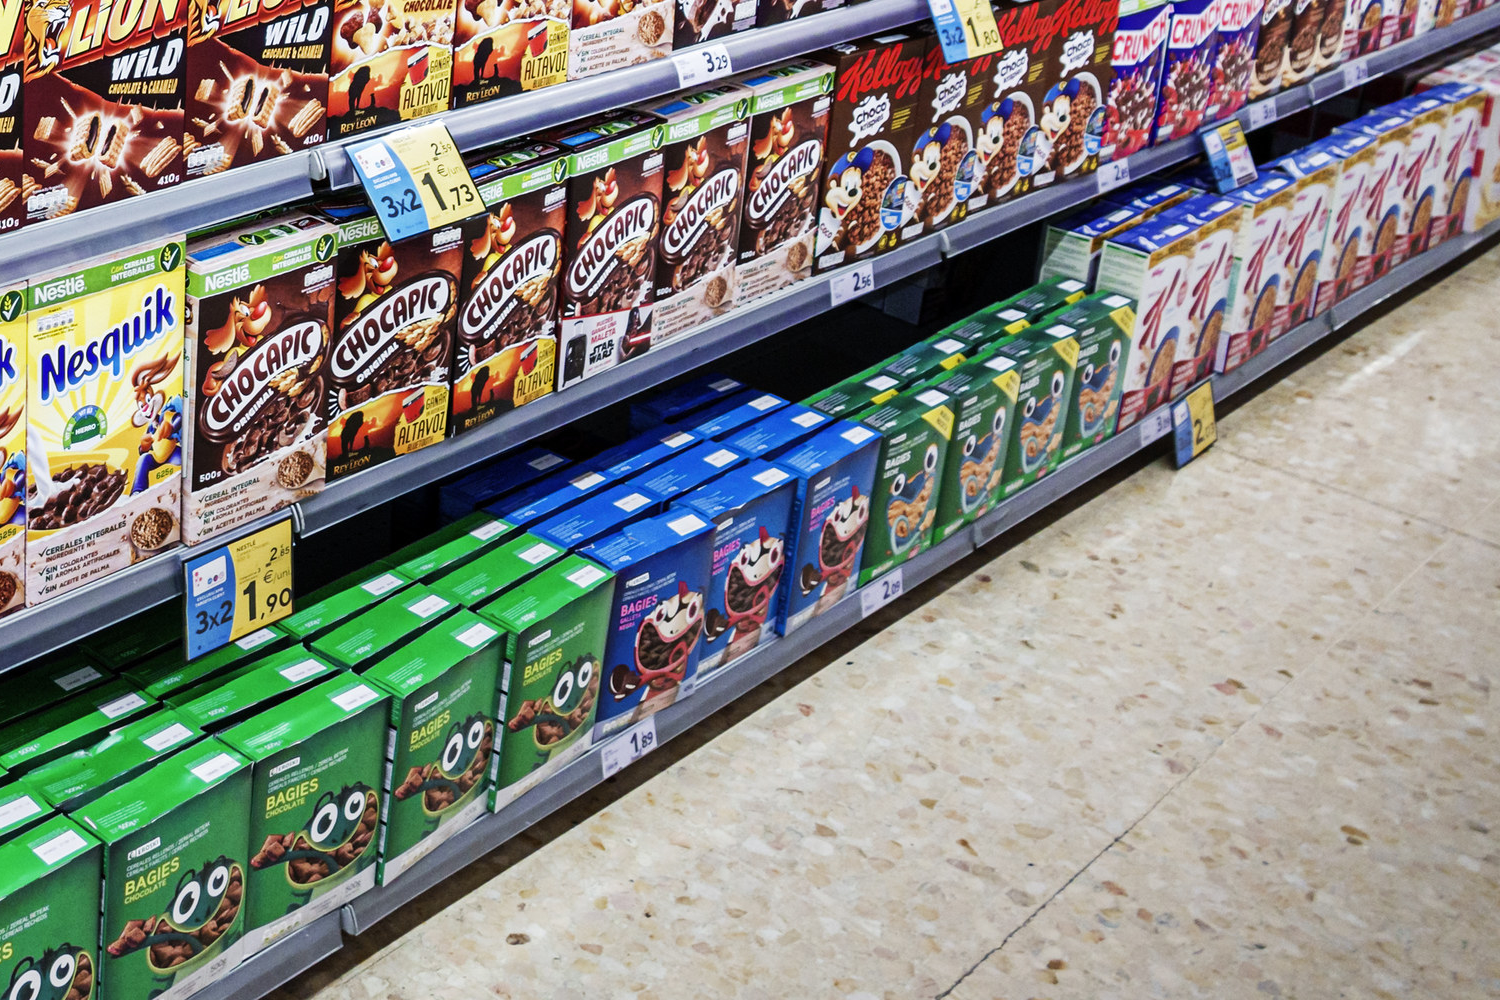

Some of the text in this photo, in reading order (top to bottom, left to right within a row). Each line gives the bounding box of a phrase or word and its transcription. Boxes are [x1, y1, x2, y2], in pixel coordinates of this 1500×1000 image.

[1112, 13, 1166, 60] CRUNCH
[1173, 6, 1220, 45] CRUNCH
[525, 51, 566, 80] ALTAVOZ
[403, 77, 449, 111] ALTAVOZ
[422, 172, 474, 211] 1,73
[750, 142, 816, 219] CHOCAPIC
[381, 189, 421, 218] 3x2
[666, 171, 735, 247] CHOCAPIC
[573, 201, 648, 290] CHOCAPIC
[466, 240, 552, 328] CHOCAPIC
[41, 288, 175, 401] Nesquik
[335, 281, 448, 374] CHOCAPIC
[216, 325, 320, 416] CHOCAPIC
[196, 601, 233, 634] 3x2
[243, 581, 292, 621] 1,90
[621, 594, 658, 617] BAGIES
[524, 649, 562, 680] BAGIES
[410, 710, 450, 743] BAGIES
[265, 779, 319, 813] BAGIES
[125, 858, 180, 897] BAGIES
